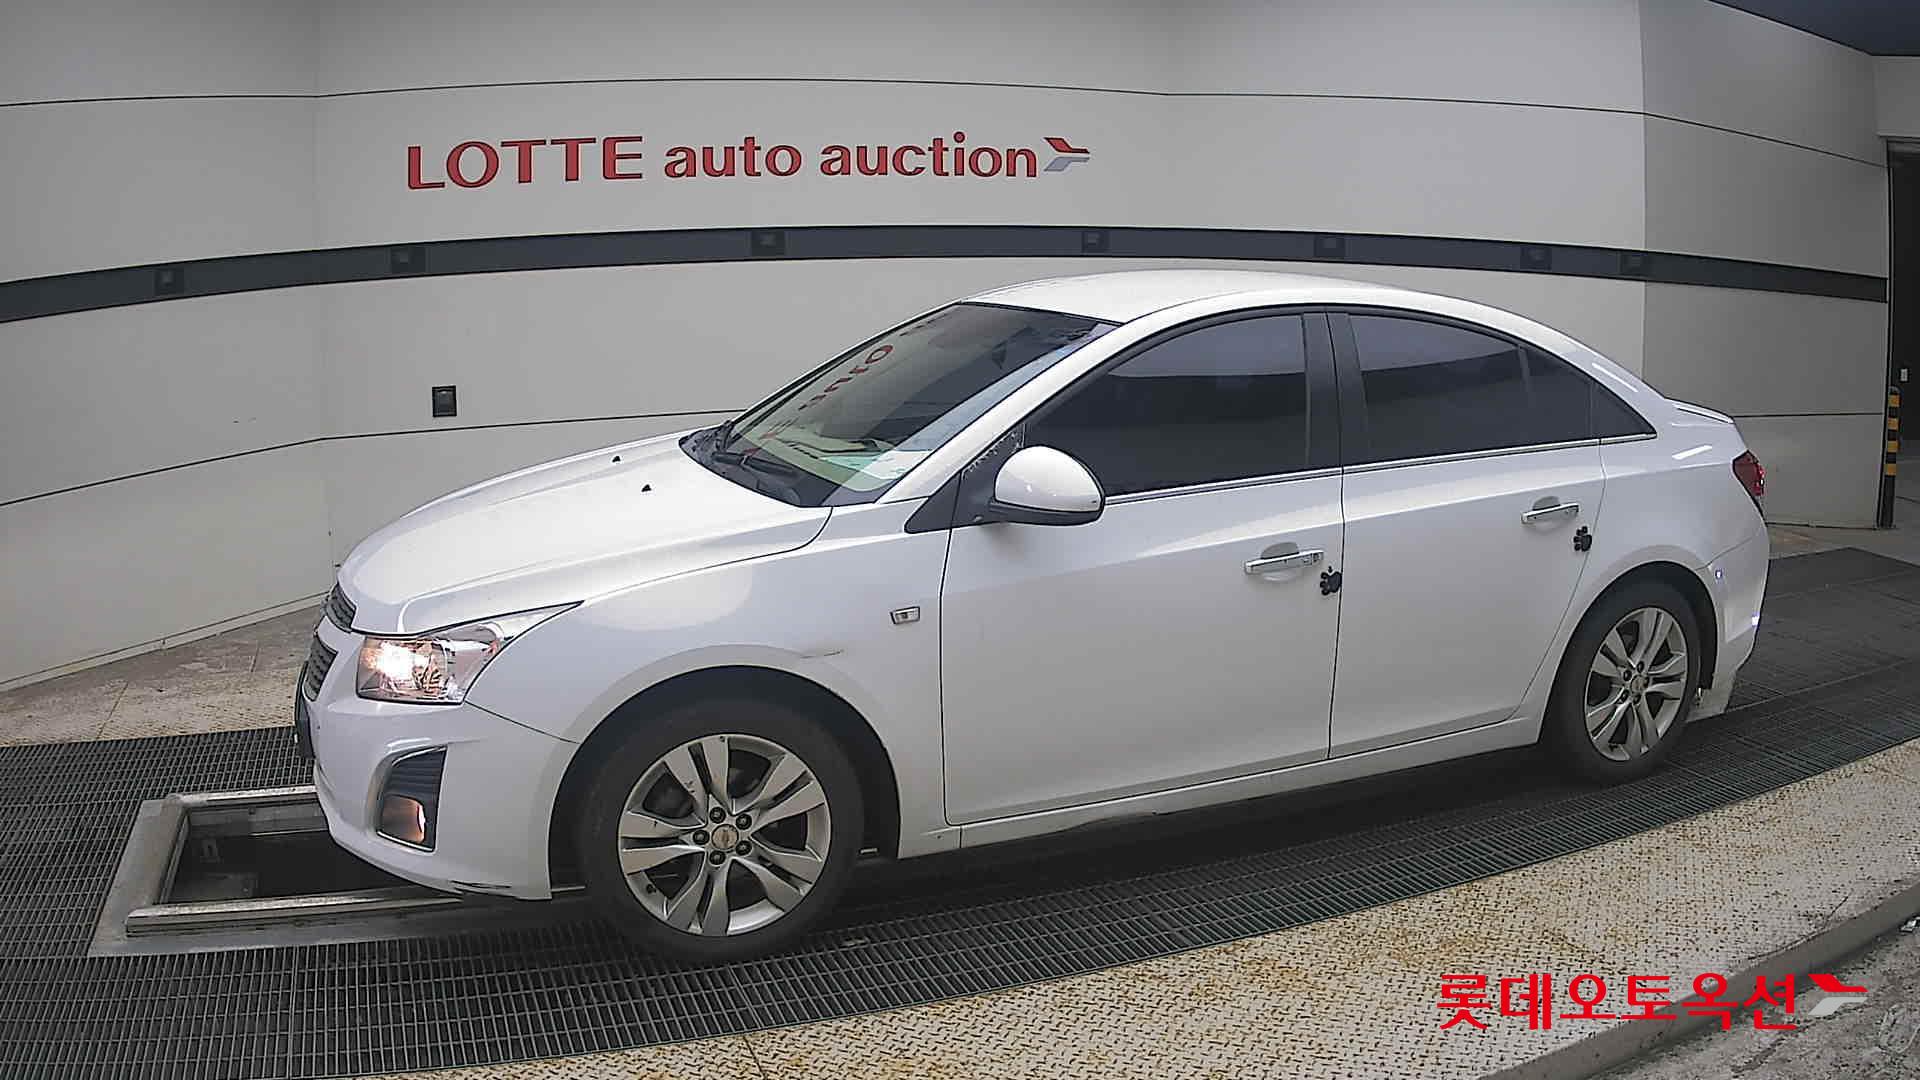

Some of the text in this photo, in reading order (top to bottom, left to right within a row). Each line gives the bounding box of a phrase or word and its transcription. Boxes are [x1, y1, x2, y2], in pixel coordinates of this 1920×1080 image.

[407, 131, 1037, 190] LOTTE auto auction
